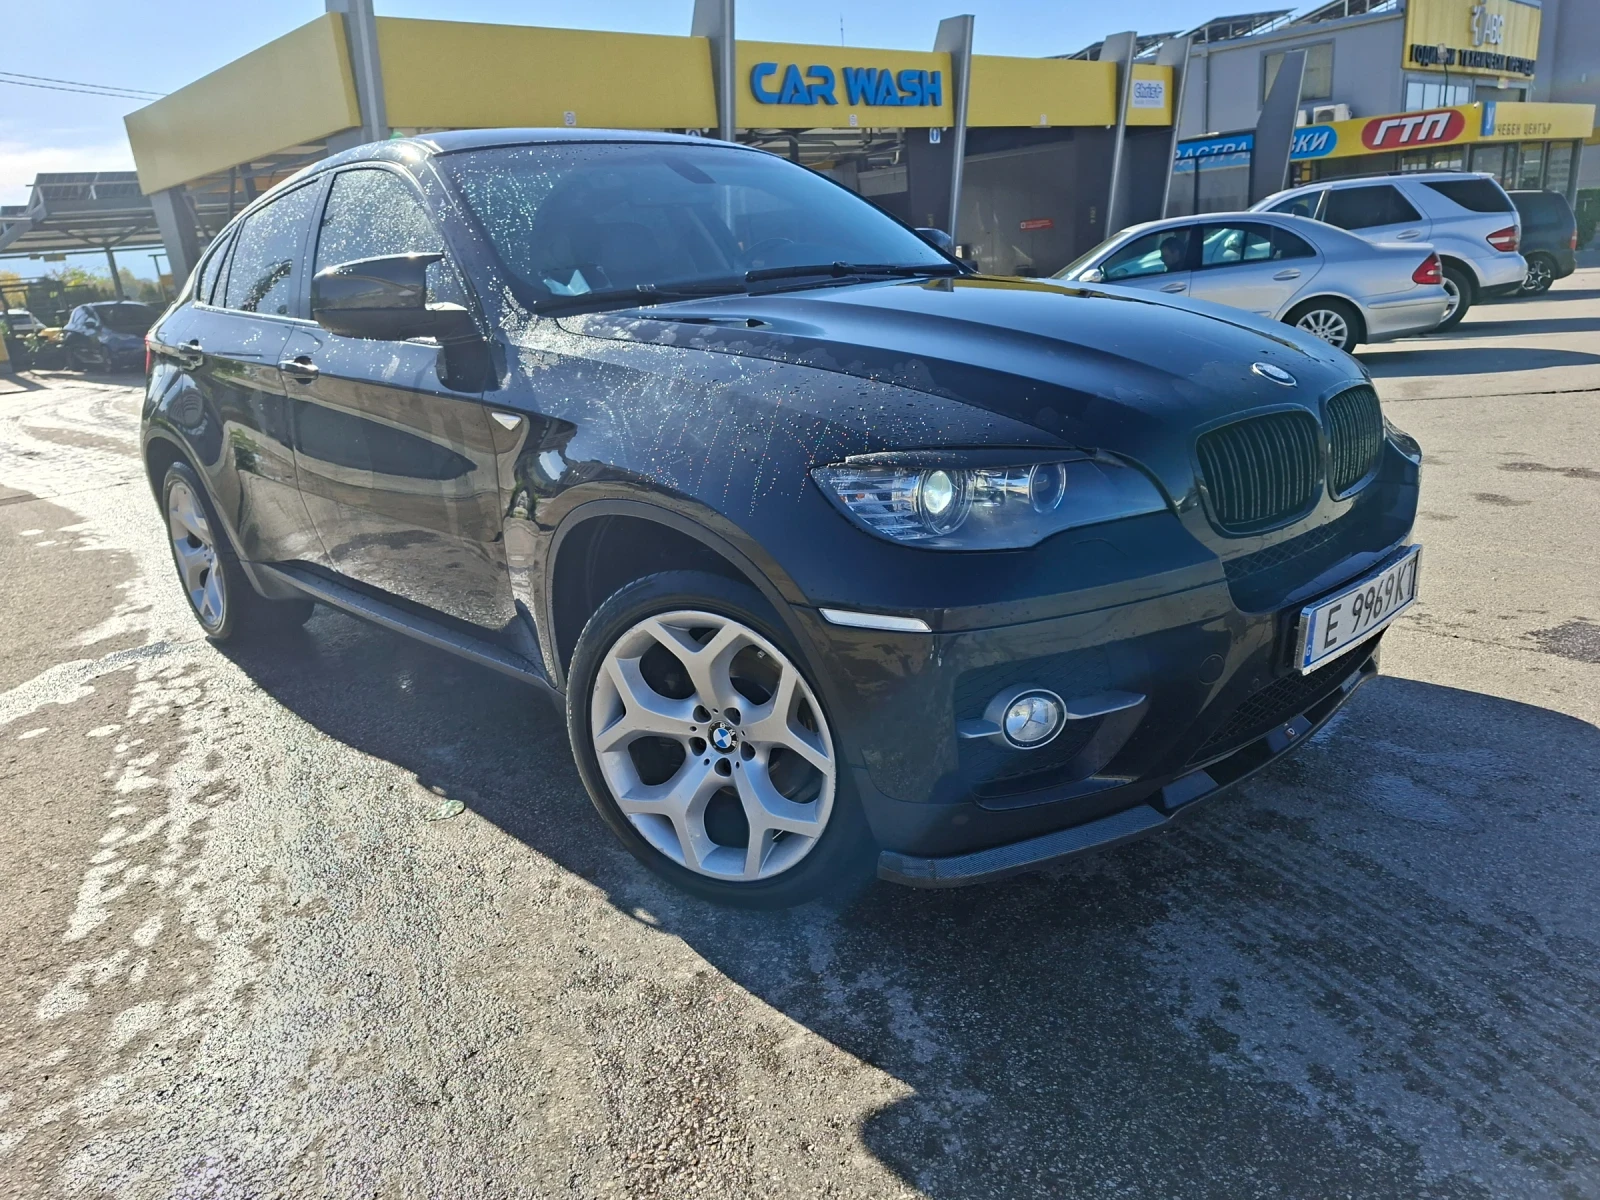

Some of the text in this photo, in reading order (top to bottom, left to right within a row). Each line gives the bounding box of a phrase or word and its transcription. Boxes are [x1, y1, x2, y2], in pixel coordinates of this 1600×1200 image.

[750, 62, 942, 106] CAR WASH
[1372, 112, 1452, 146] ГТП
[1324, 603, 1342, 649] E
